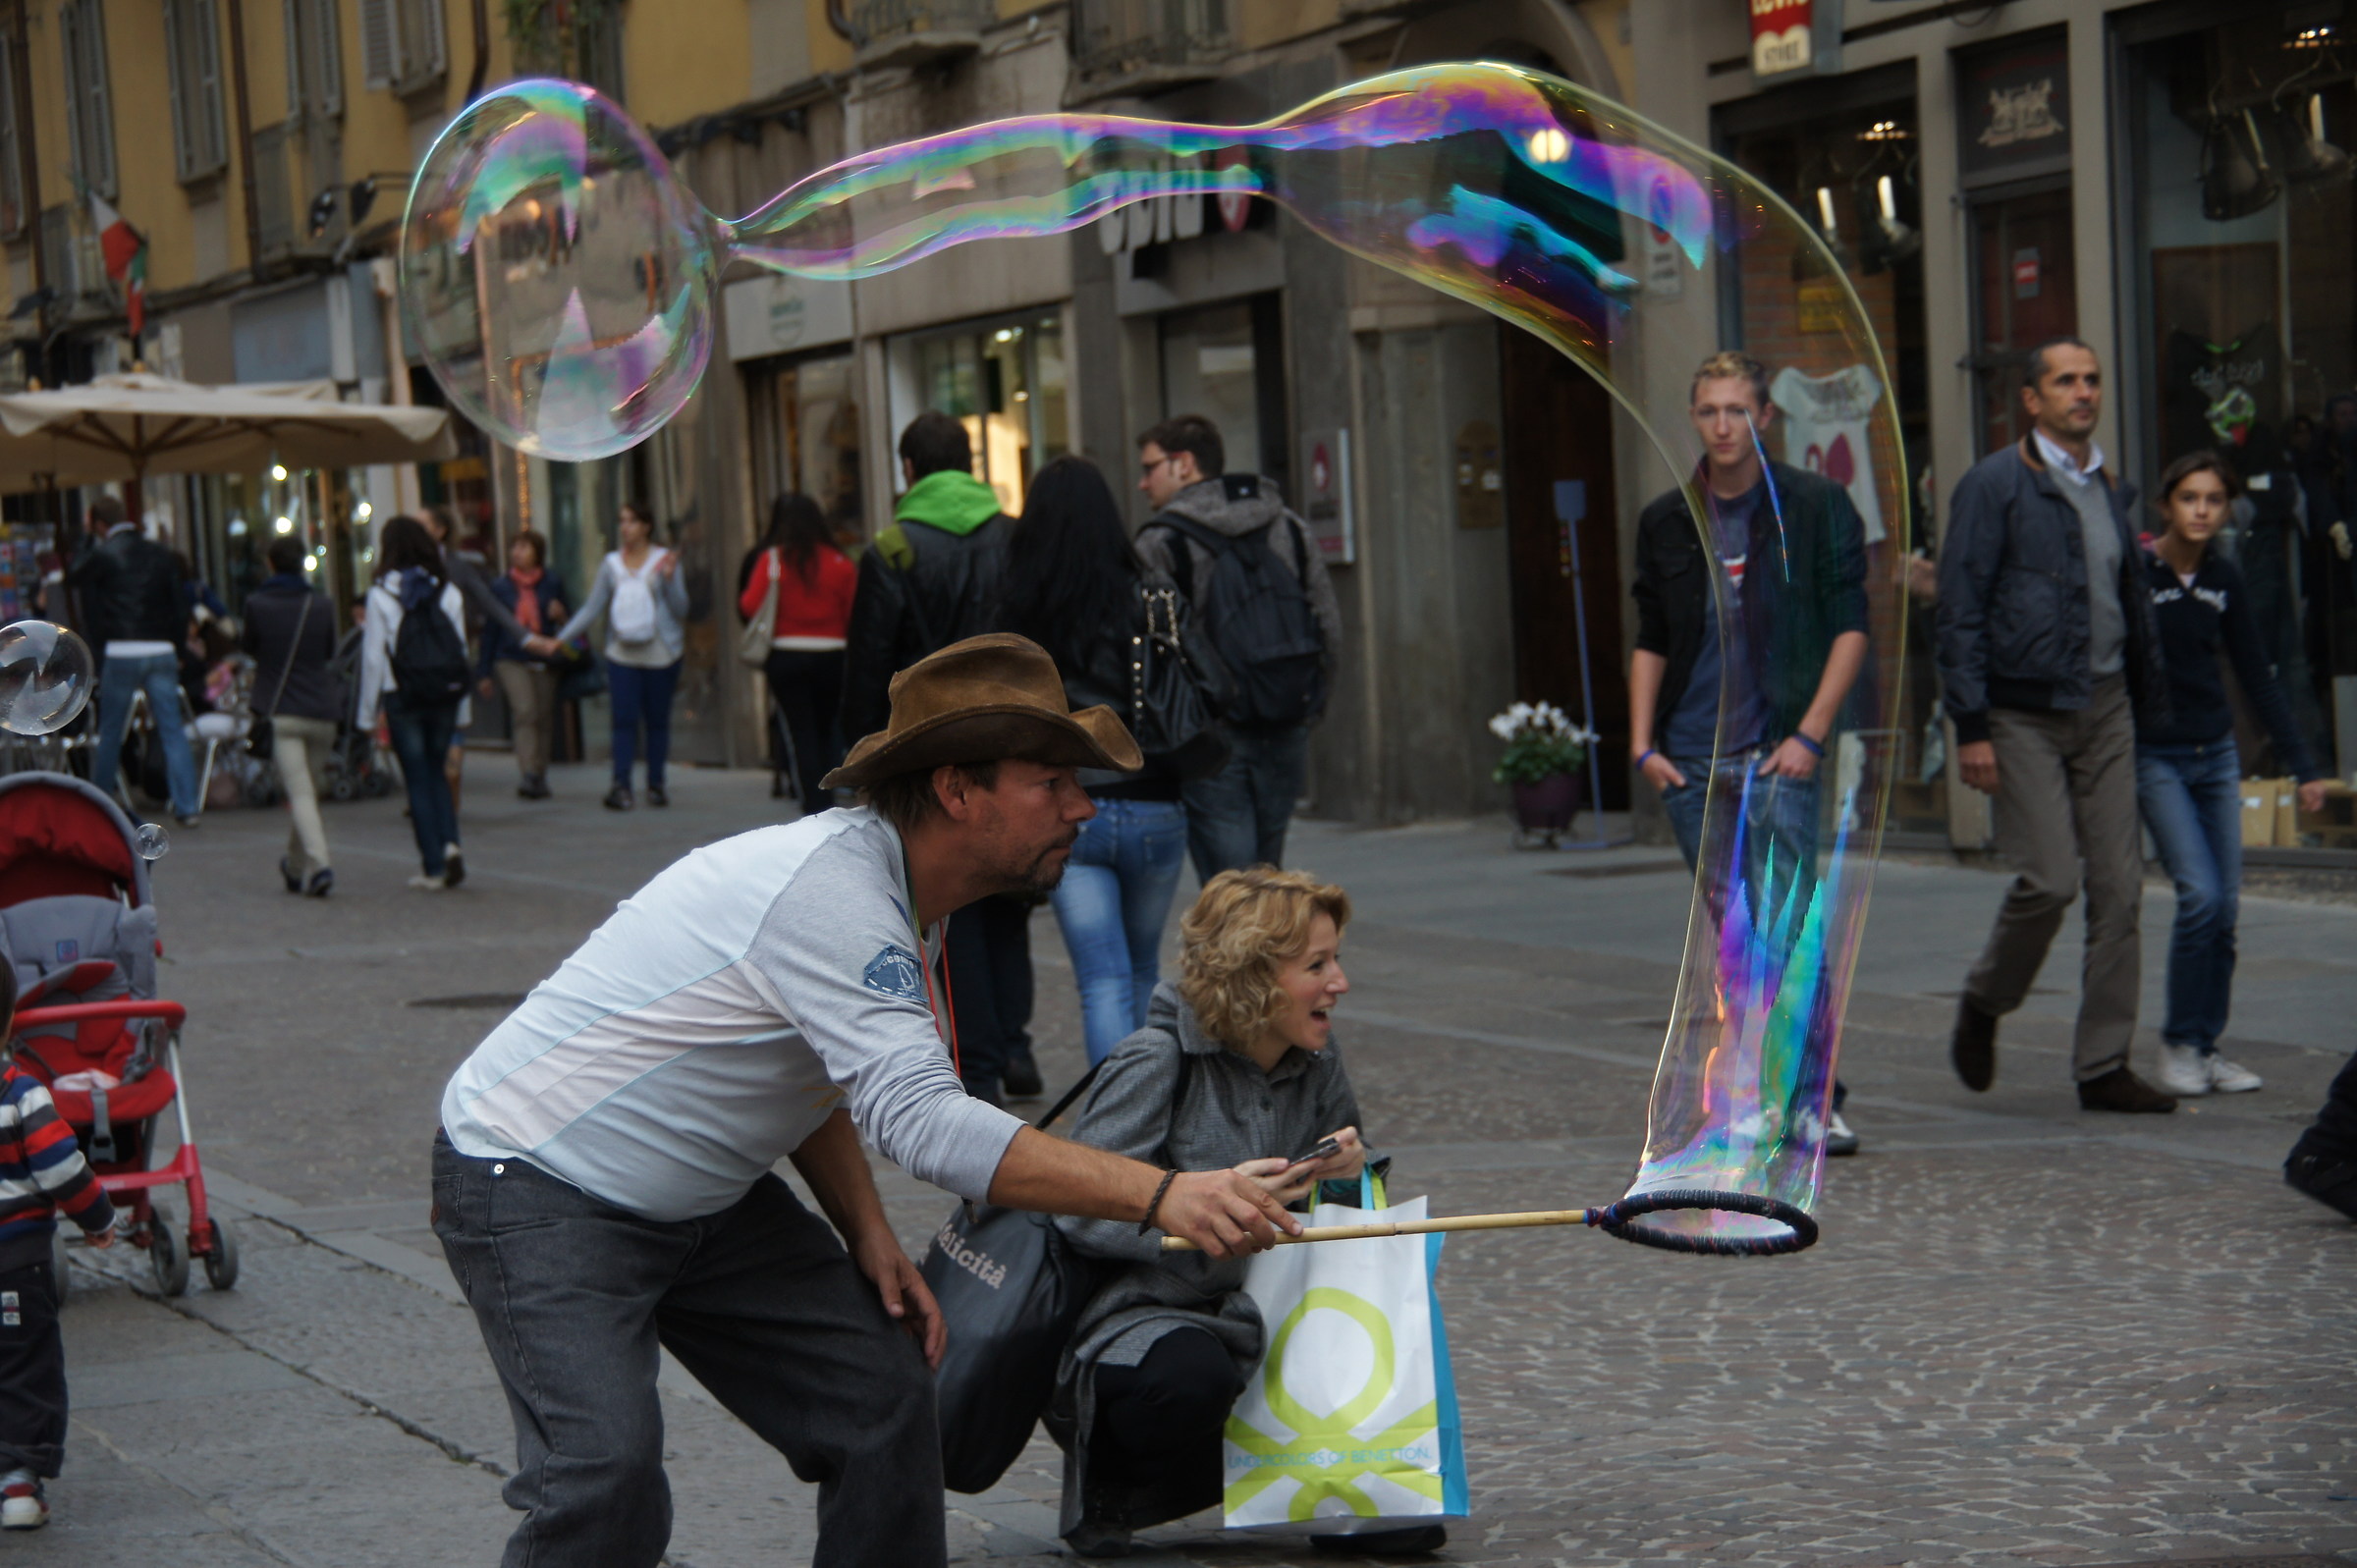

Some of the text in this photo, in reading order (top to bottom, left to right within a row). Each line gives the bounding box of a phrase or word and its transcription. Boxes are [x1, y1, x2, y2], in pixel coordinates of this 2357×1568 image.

[938, 1223, 1007, 1289] elicità
[1228, 1452, 1325, 1469] UNDERCOLORS
[1329, 1450, 1346, 1464] OF
